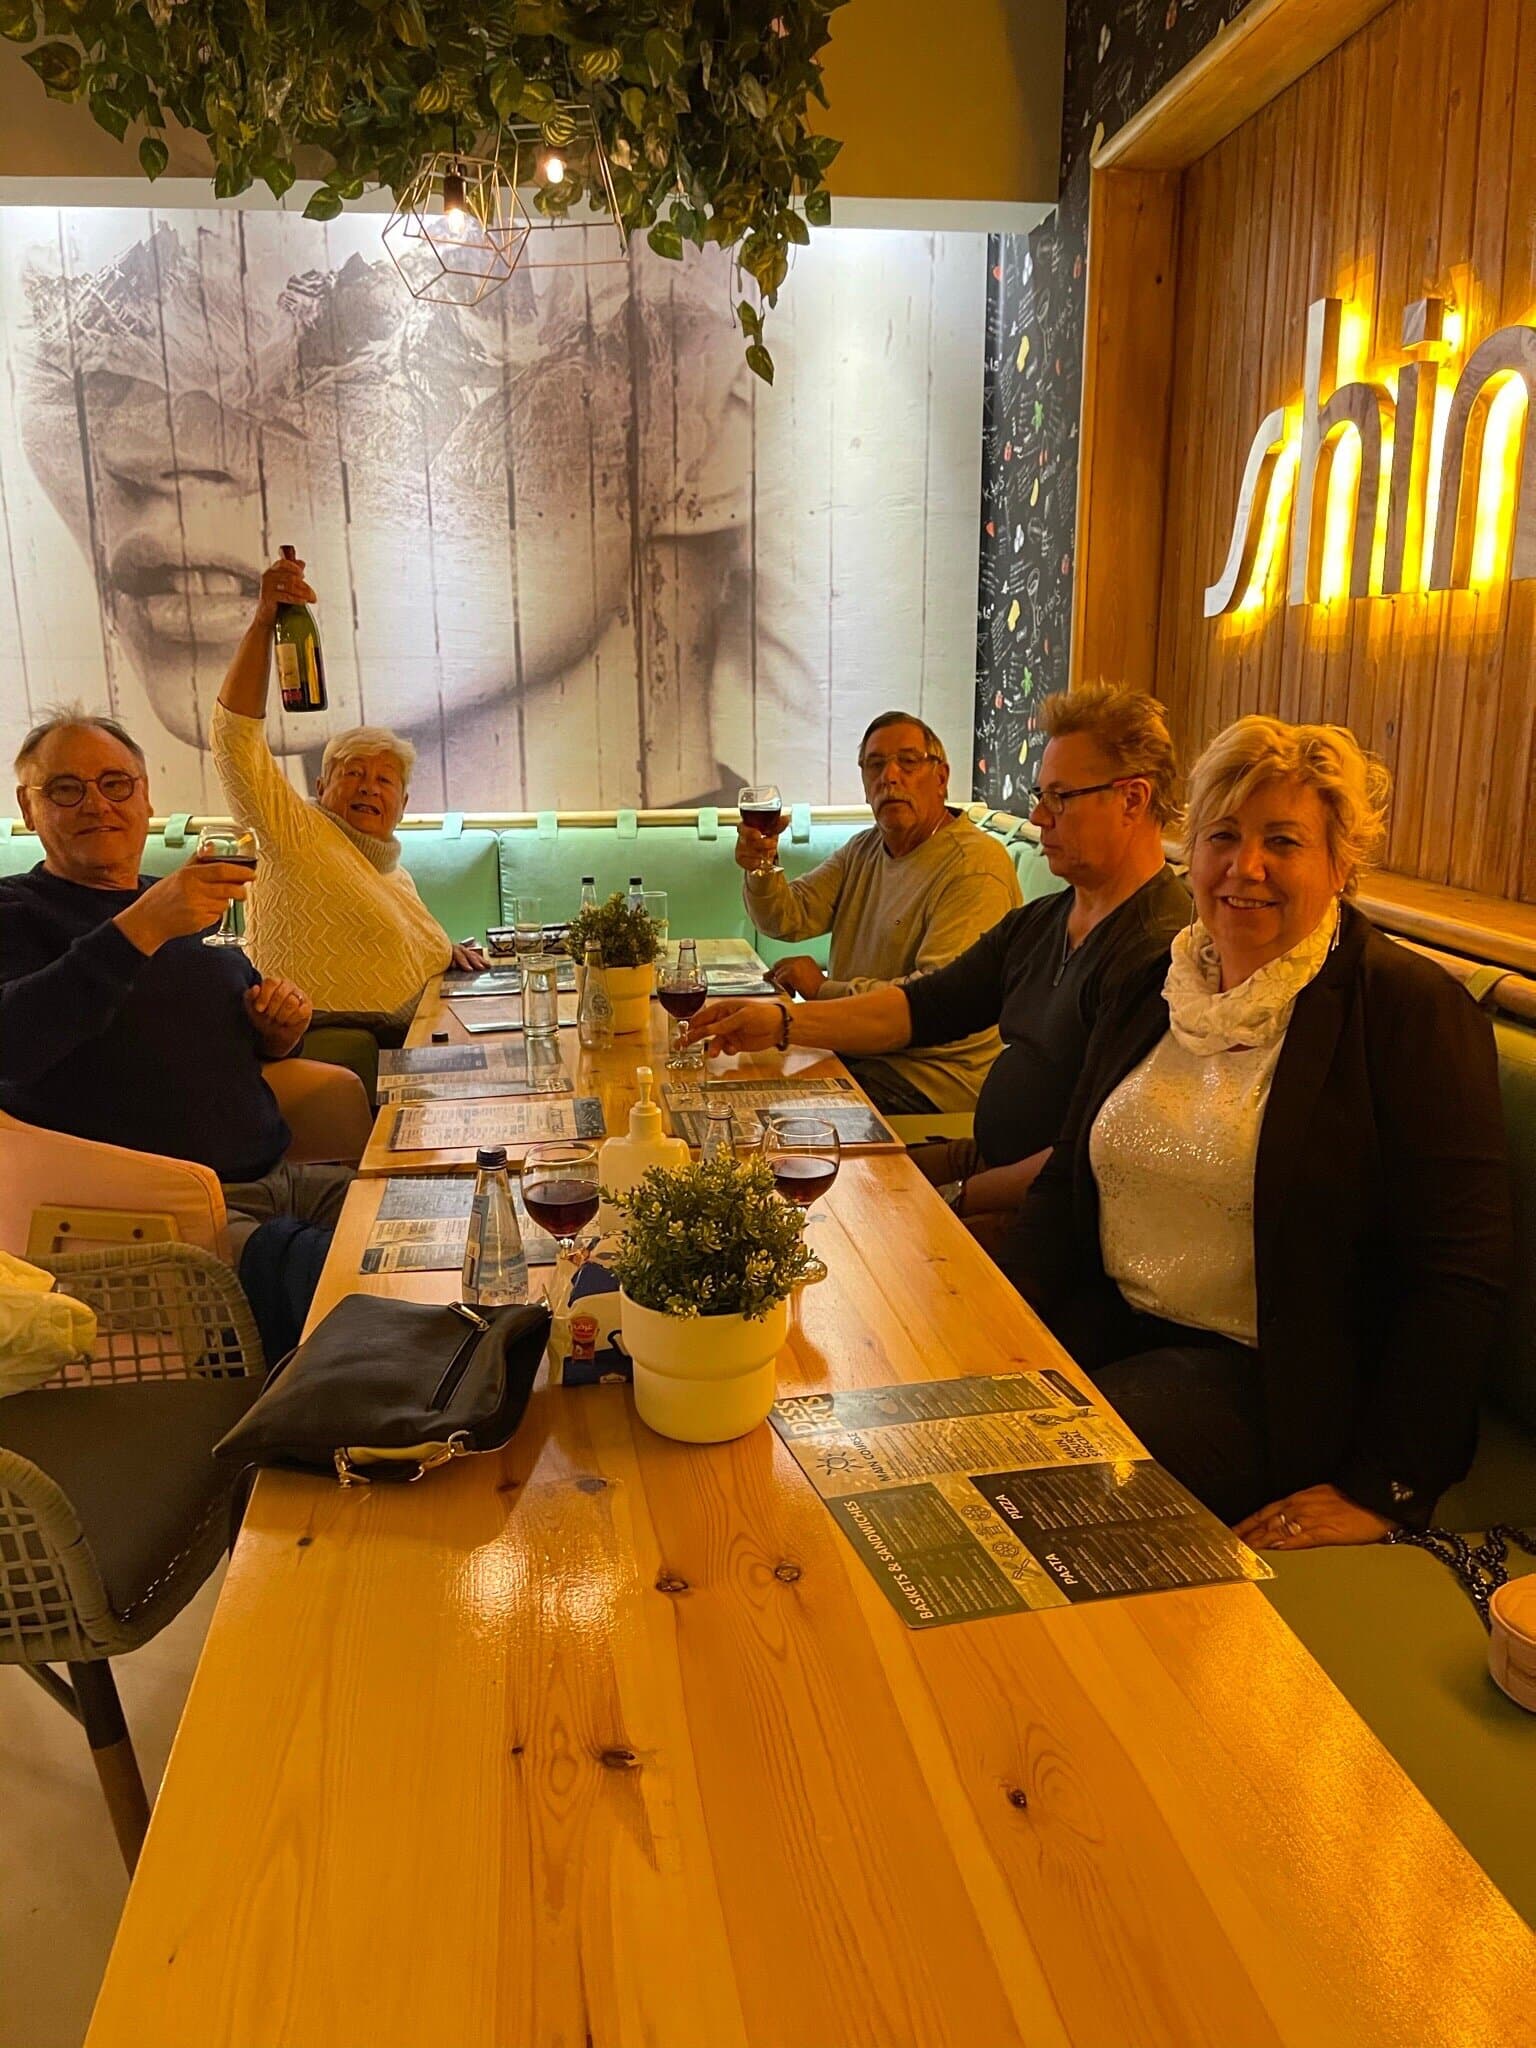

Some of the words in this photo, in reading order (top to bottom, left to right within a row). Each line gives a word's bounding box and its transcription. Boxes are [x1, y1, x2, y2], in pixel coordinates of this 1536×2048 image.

[774, 1399, 817, 1435] DESS
[799, 1395, 843, 1432] ERTS
[847, 1432, 874, 1460] COURSE
[1056, 1439, 1080, 1459] MAIN
[1058, 1431, 1090, 1458] COURSE
[1070, 1429, 1103, 1457] SPECIAL
[870, 1460, 891, 1482] MAIN
[994, 1493, 1023, 1520] PIZZA
[843, 1499, 895, 1563] SANDWICHES
[887, 1560, 902, 1574] &
[1044, 1553, 1079, 1585] PASTA
[893, 1573, 935, 1620] BASKETS
